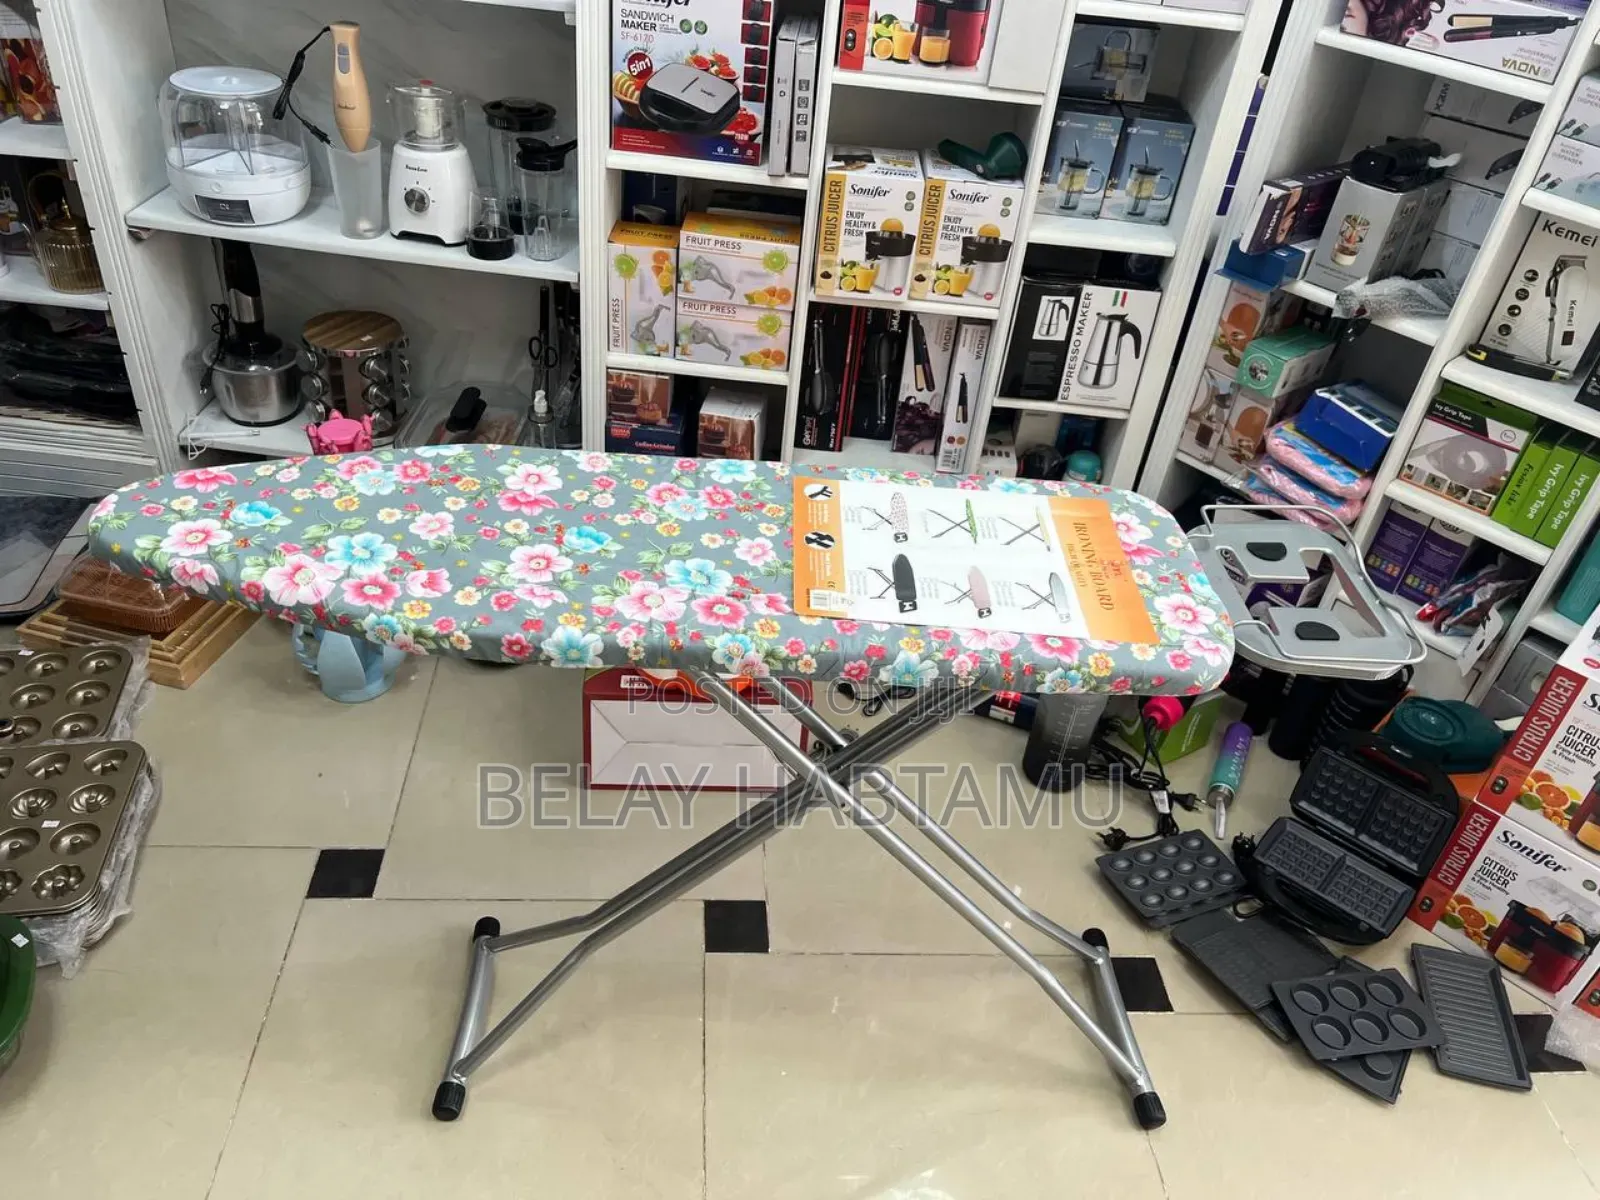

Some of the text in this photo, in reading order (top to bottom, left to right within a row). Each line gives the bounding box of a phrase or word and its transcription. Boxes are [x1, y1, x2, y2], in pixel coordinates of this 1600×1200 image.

[620, 8, 675, 24] SANDWICH
[620, 20, 657, 32] MAKER
[630, 57, 652, 76] 5in1
[1501, 56, 1541, 76] NOVA
[849, 183, 891, 198] Sonifer
[949, 188, 990, 204] Sonifer
[823, 180, 842, 252] CITRUS JUICER
[845, 210, 865, 219] ENJOY
[919, 184, 942, 256] CITRUS JUICER
[943, 215, 962, 225] ENJOY
[685, 235, 712, 247] FRUIT
[714, 238, 742, 251] PRESS
[843, 228, 865, 237] FRESH
[940, 232, 961, 242] FRESH
[1541, 219, 1599, 248] Kemei
[682, 301, 737, 315] FRUIT PRESS
[1060, 292, 1093, 401] ESPRESSO MAKER
[1526, 463, 1564, 519] Ivy Grip Tape
[1551, 474, 1590, 530] Ivy Grip Tape
[1073, 521, 1115, 611] IRONING BOARD
[1513, 715, 1550, 762] CITRUS
[1538, 675, 1578, 725] JUICER
[1558, 734, 1597, 759] JUICER
[1437, 846, 1470, 886] CITRUS
[1458, 813, 1492, 854] JUICER
[1497, 829, 1567, 873] Sonifer
[1476, 864, 1510, 888] JUICER
[1483, 855, 1518, 881] CITRUS
